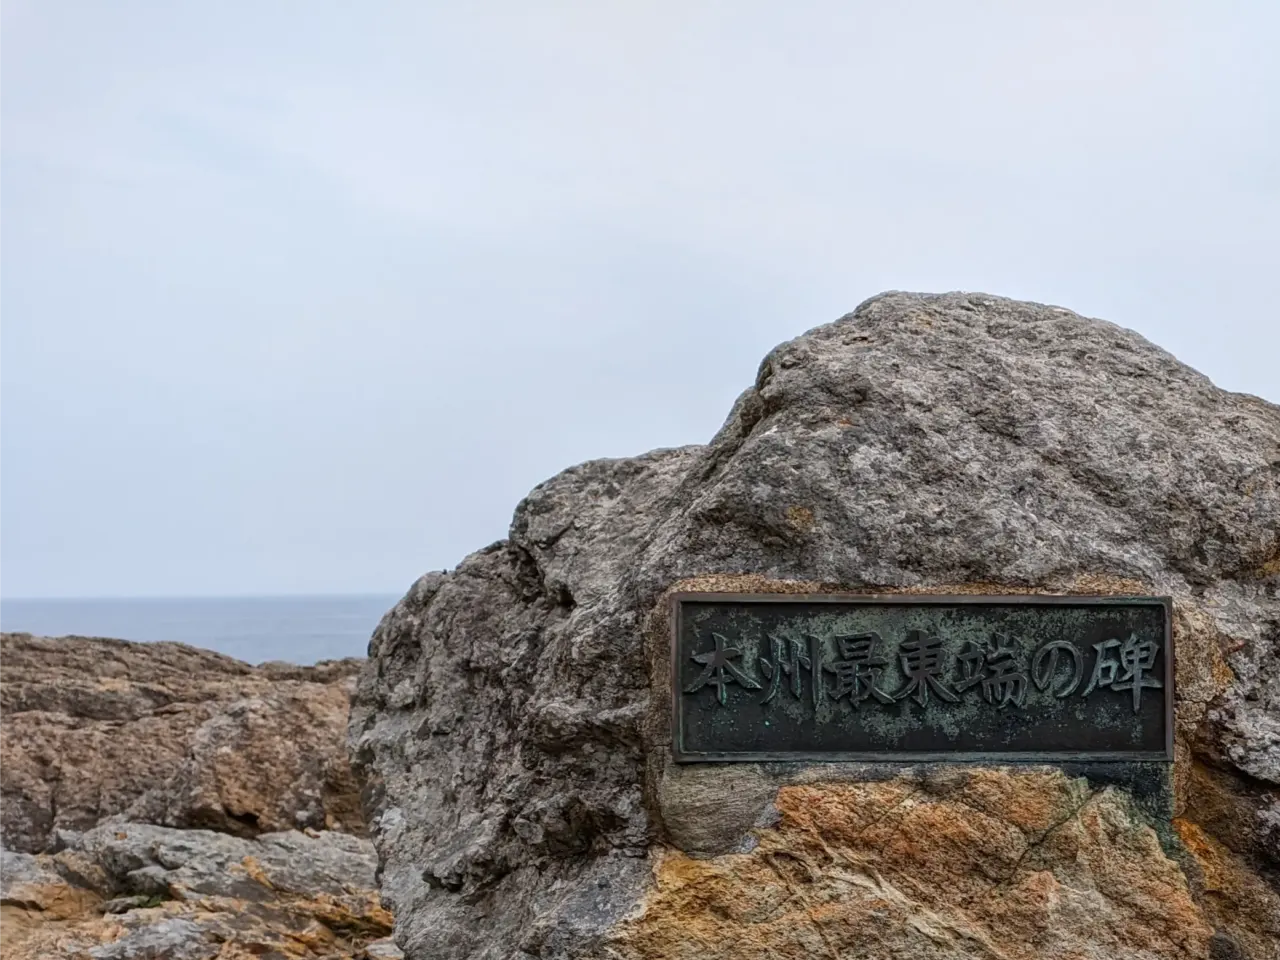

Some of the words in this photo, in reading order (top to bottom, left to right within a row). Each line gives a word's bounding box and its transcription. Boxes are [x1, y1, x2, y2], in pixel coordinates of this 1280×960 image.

[683, 630, 1163, 714] 本州最東端の碑
